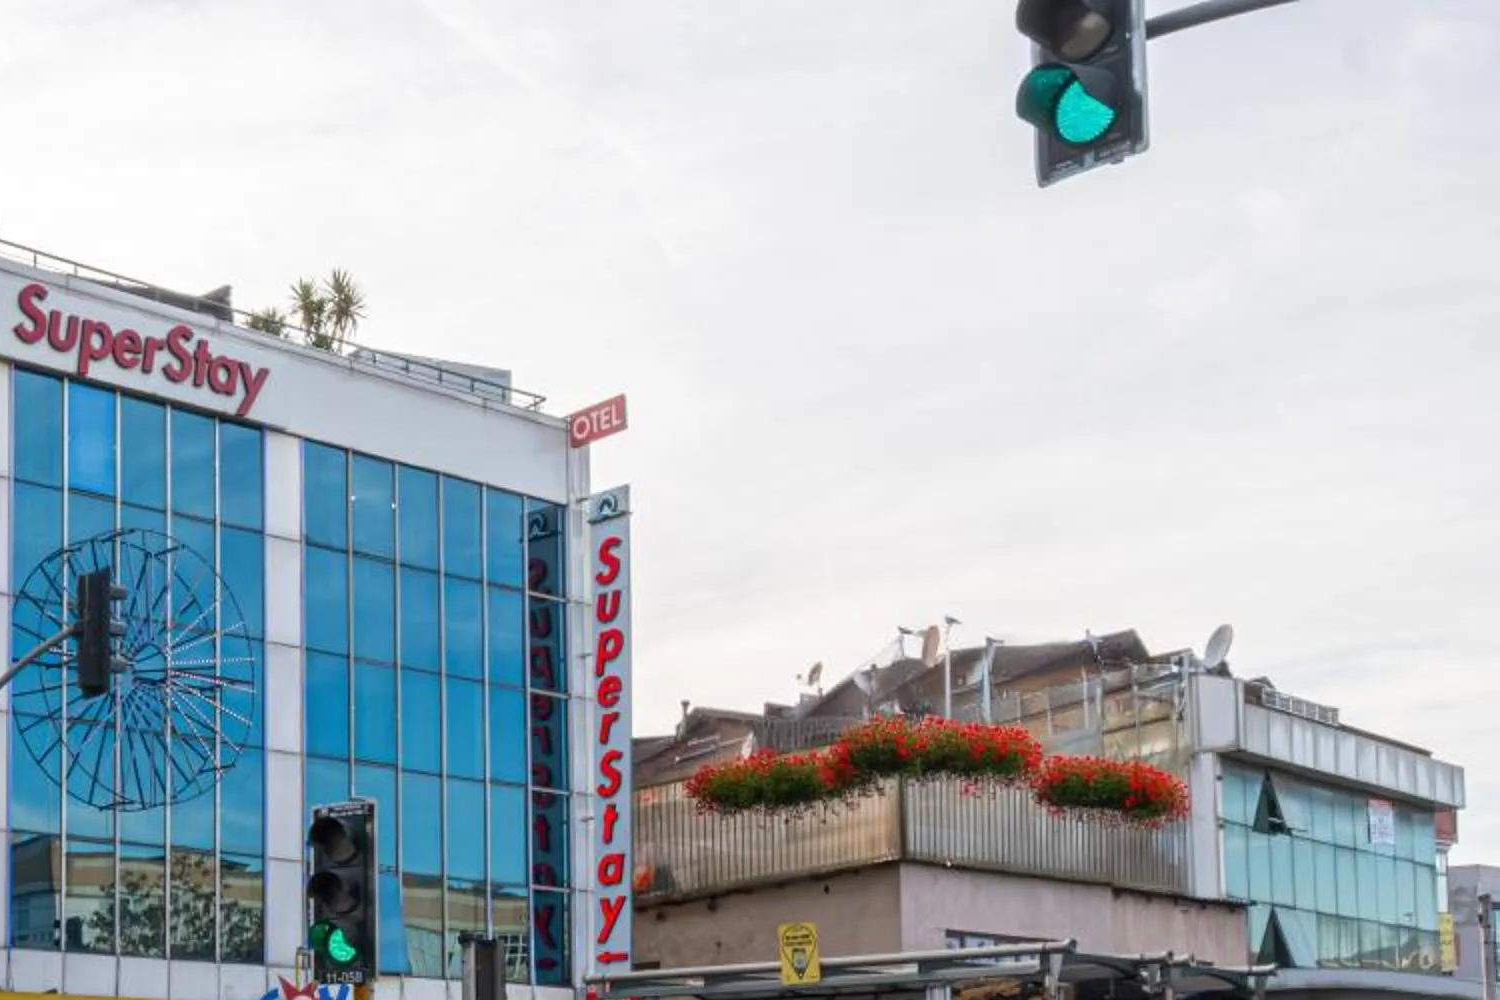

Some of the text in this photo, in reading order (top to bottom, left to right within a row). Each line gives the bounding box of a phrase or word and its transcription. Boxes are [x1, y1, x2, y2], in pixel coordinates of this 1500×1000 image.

[13, 283, 270, 417] SuperStay
[573, 404, 622, 440] OTEL
[595, 536, 628, 946] SuperStay
